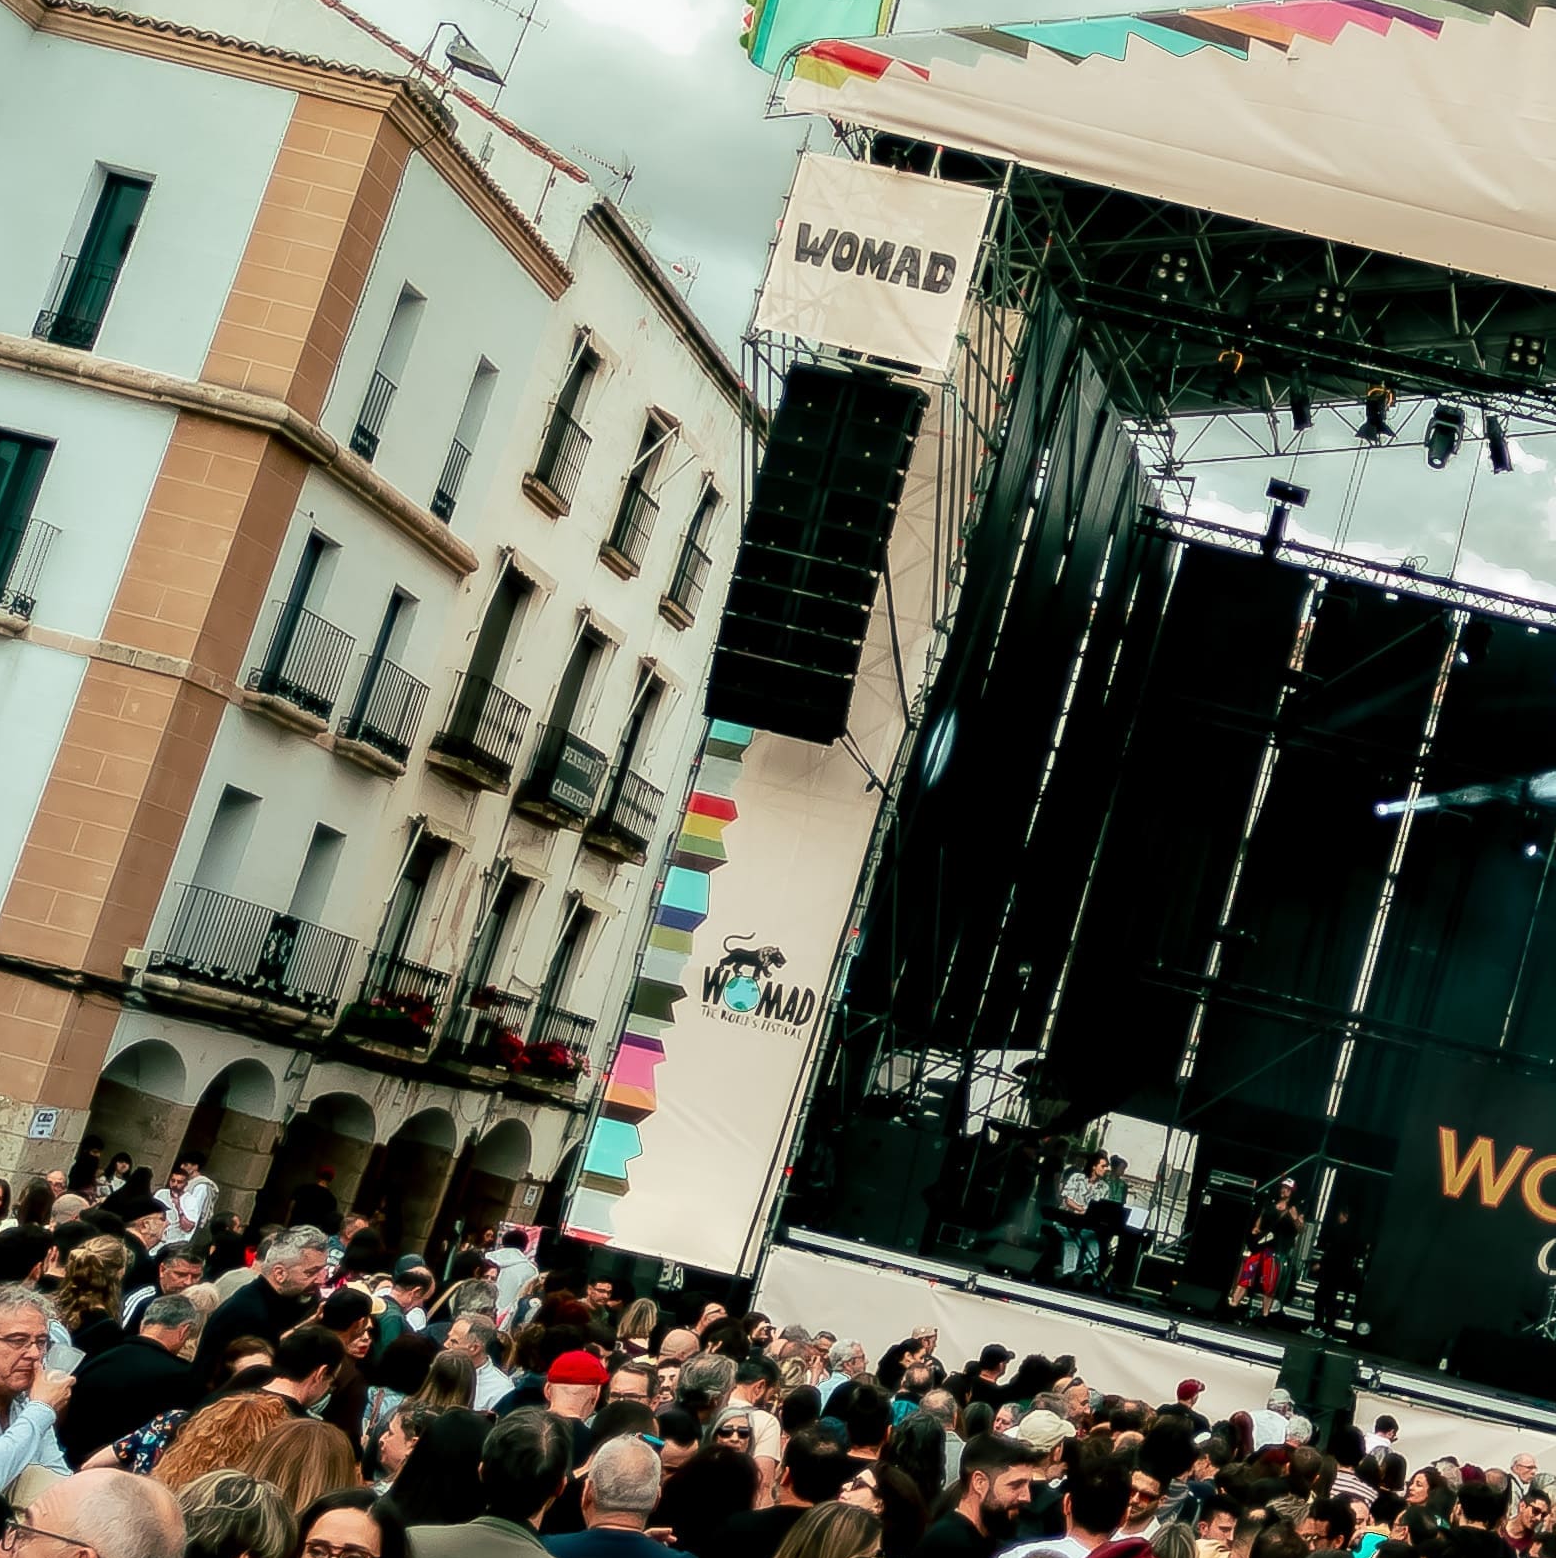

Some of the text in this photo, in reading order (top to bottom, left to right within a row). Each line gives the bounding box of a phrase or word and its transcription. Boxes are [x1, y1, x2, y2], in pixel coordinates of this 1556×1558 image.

[795, 221, 956, 294] WOMAD
[701, 1005, 717, 1020] THE
[702, 966, 816, 1026] WOMAD
